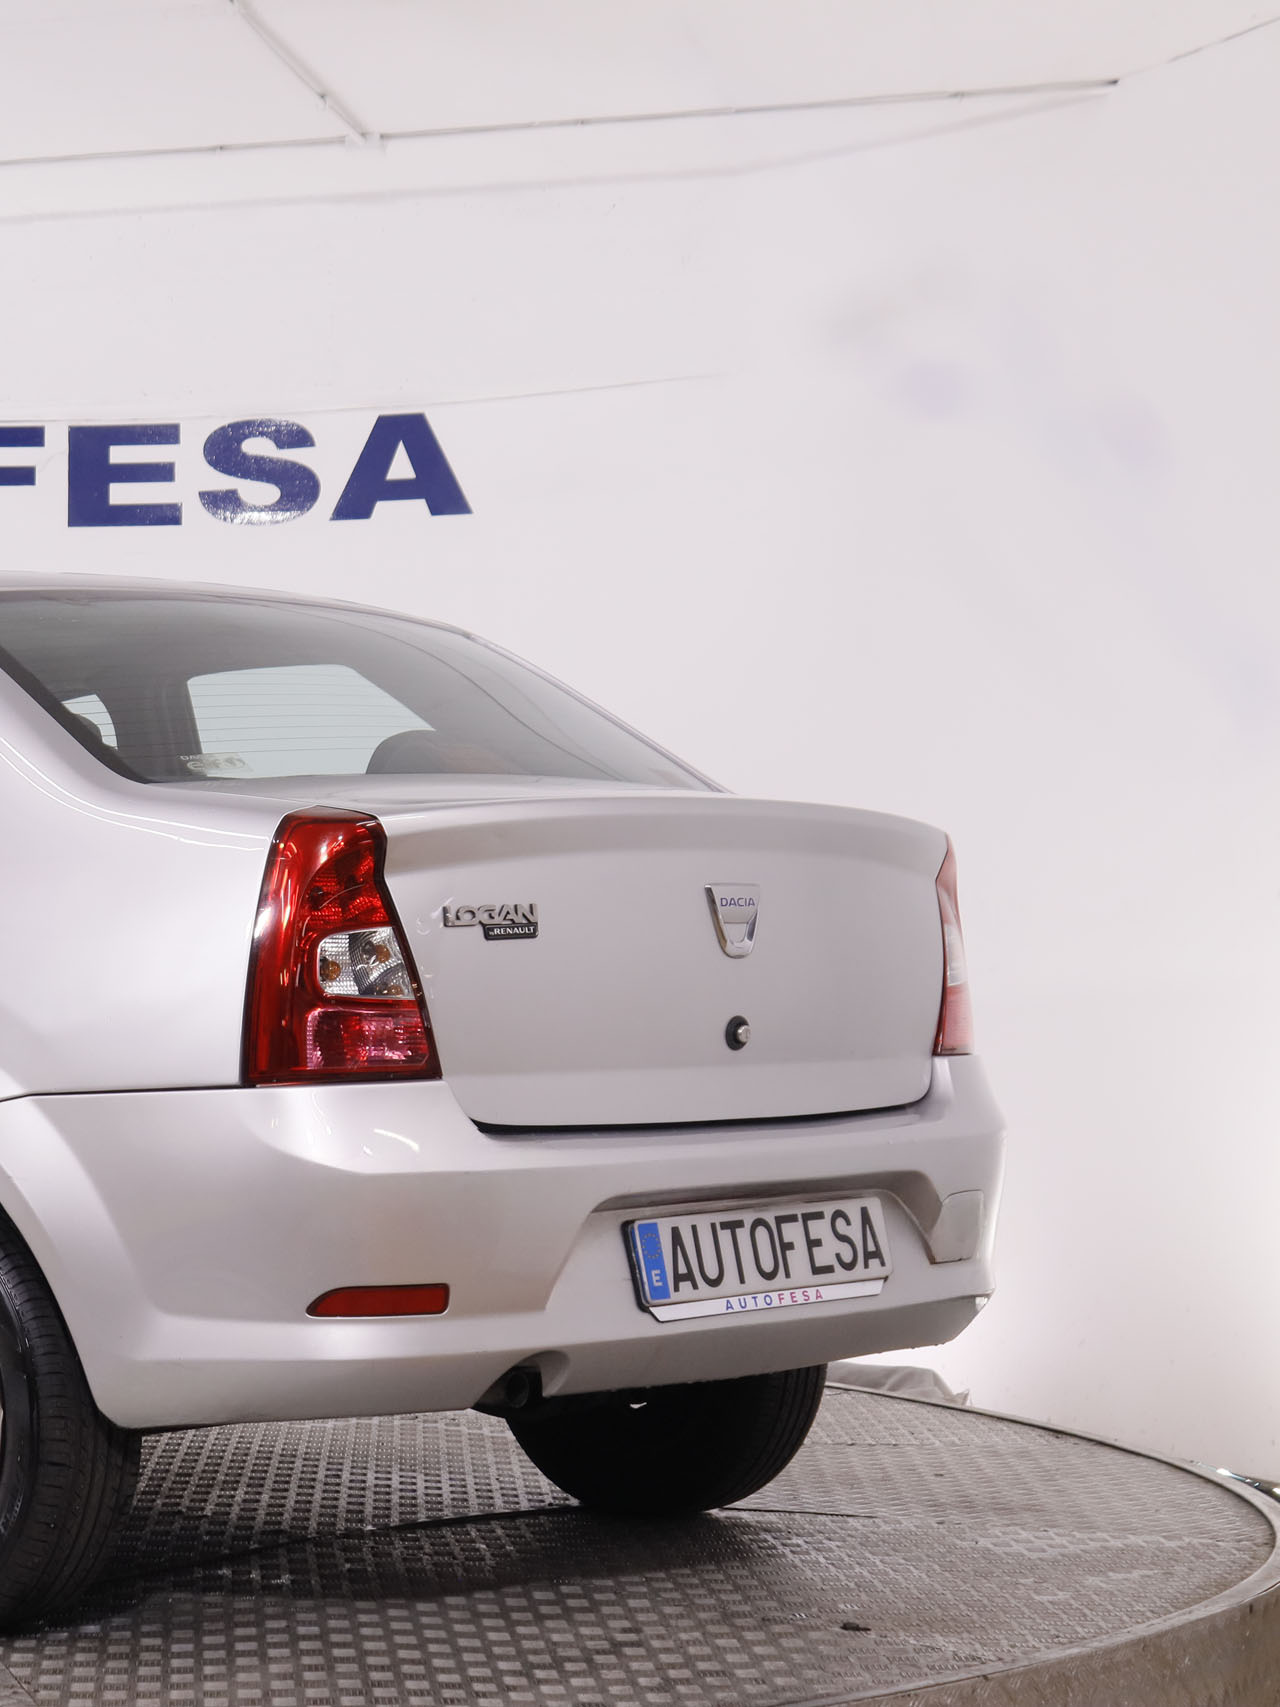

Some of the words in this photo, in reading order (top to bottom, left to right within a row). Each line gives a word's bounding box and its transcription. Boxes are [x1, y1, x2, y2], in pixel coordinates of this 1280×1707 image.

[720, 897, 756, 908] DACIA
[443, 903, 539, 926] LOGAN
[494, 926, 535, 936] RENAULT
[671, 1206, 886, 1292] AUTOFESA
[651, 1269, 663, 1287] E
[725, 1289, 824, 1312] AUTOFESA
